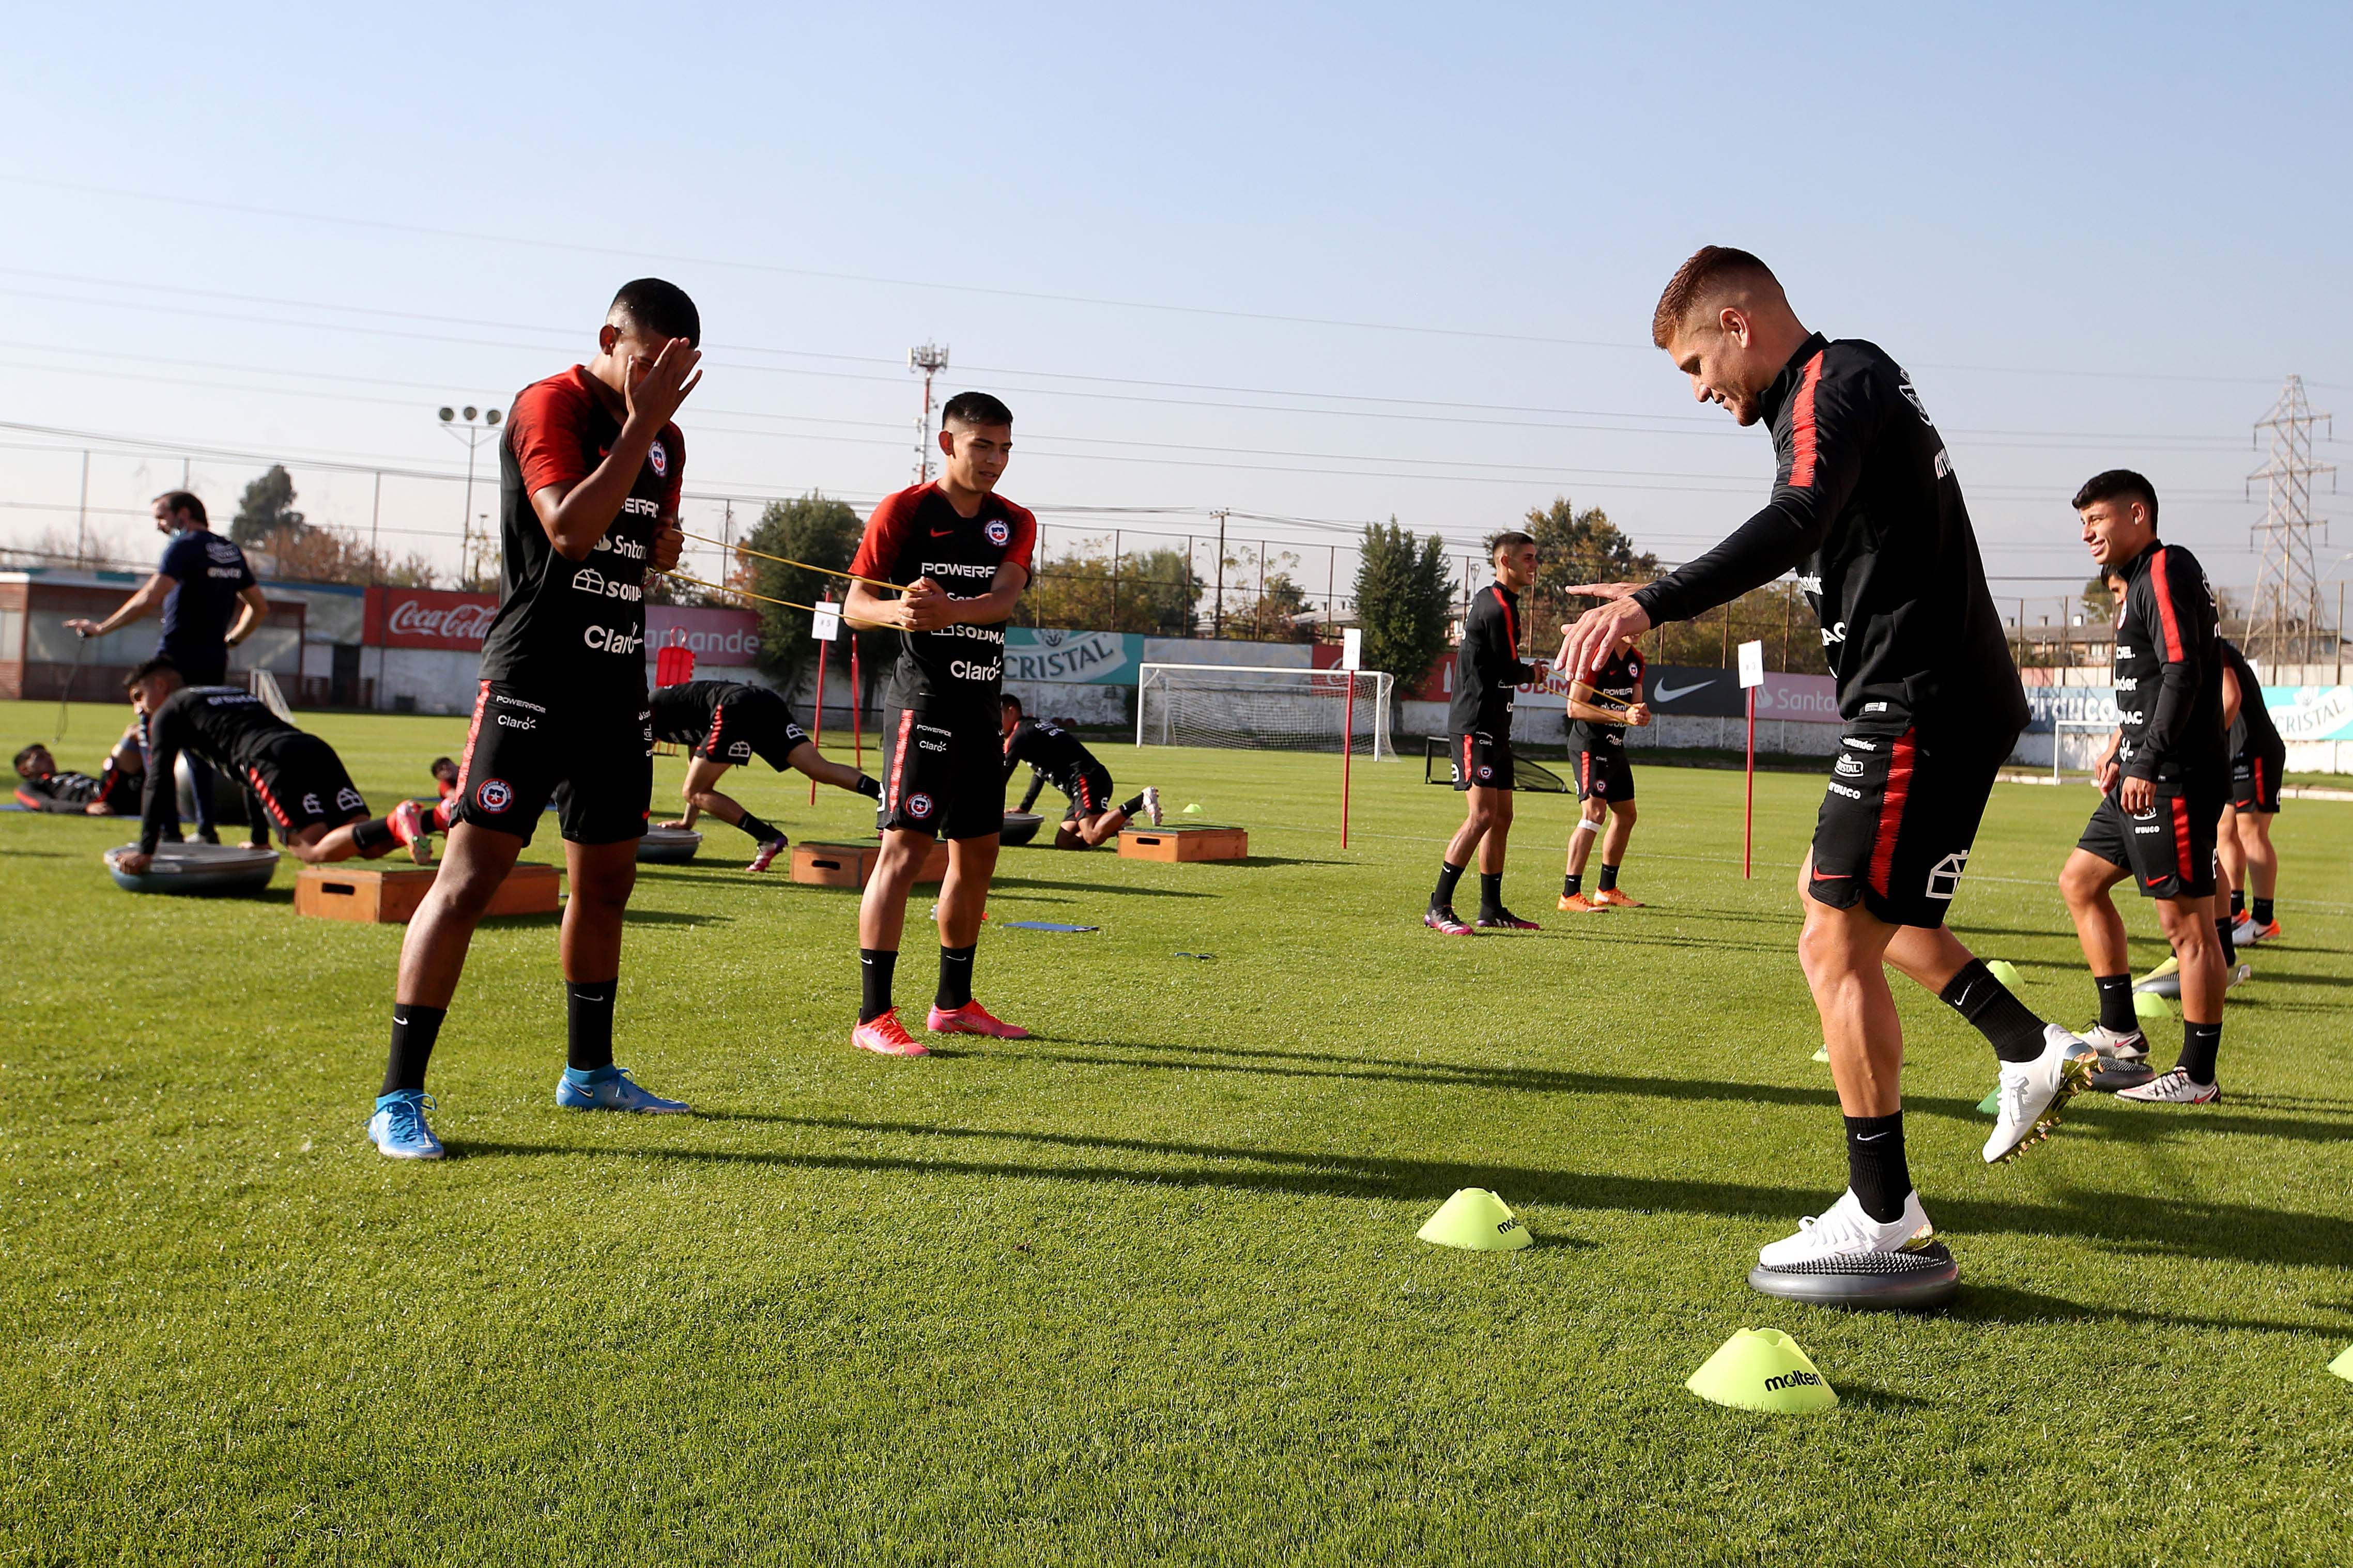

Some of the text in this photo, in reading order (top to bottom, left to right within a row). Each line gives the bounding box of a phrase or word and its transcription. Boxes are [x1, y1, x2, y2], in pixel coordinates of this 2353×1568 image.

[1004, 638, 1113, 678] CRISTAL
[950, 659, 997, 681] Claro
[496, 695, 546, 713] POWERADE
[498, 715, 531, 730] Claro
[2274, 698, 2346, 734] CRISTAL
[919, 740, 943, 752] Claro
[1764, 1370, 1823, 1392] molten
